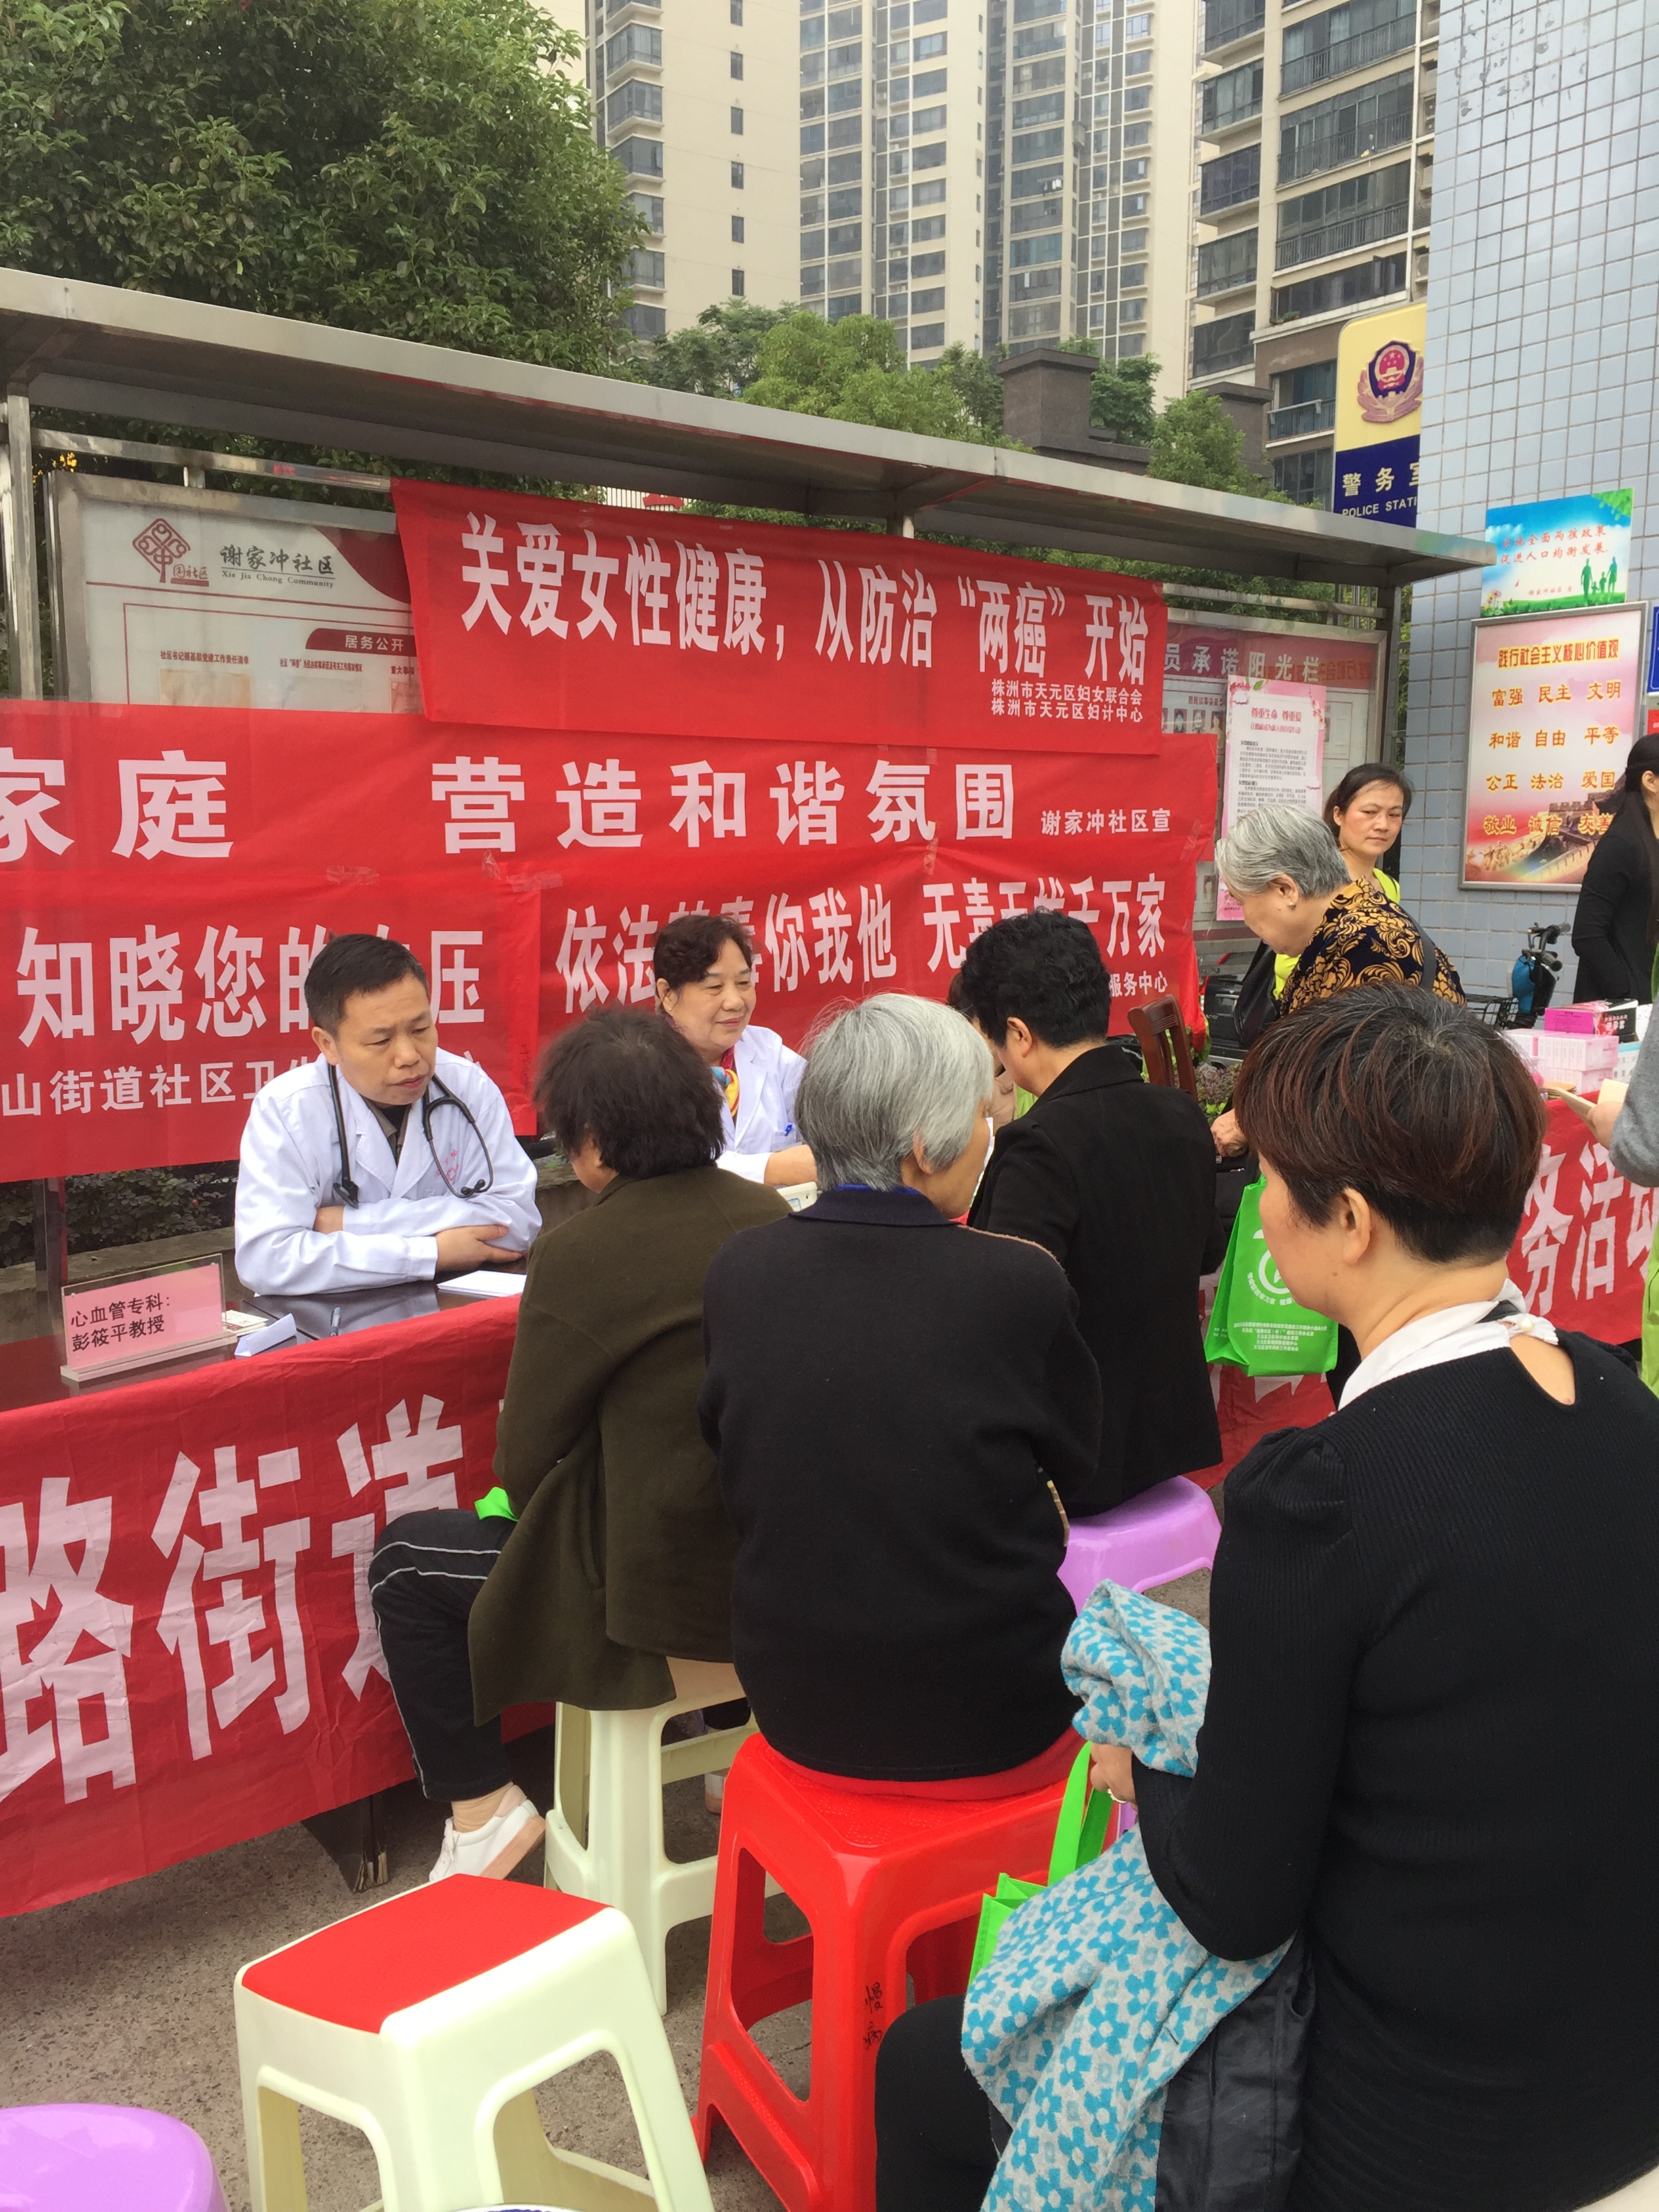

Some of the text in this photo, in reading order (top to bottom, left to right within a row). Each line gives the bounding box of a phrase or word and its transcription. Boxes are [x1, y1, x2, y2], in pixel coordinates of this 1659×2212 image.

[1342, 504, 1379, 516] POLICE
[220, 544, 334, 575] 谢家冲社区
[222, 570, 334, 588] Xie Jia Chong Community
[345, 634, 404, 652] 居务公开
[1498, 639, 1619, 668] 践行社会主义核心价值观
[1164, 643, 1319, 682] 员承诺阳光栏
[991, 678, 1142, 705] 株洲市天元区妇女联合会
[1492, 681, 1621, 707] 富强 民主 文明
[991, 697, 1143, 723] 株洲市天元区妇计中心
[1489, 726, 1620, 749] 和谐 自由 平等
[1486, 771, 1615, 791] 公正 法治 爱国
[0, 748, 1015, 862] 家庭 营造和谐氛围
[1041, 808, 1171, 836] 谢家冲社区宣
[1484, 813, 1614, 835] 敬业 诚信 友善
[556, 883, 897, 1014] 依法你我他
[17, 924, 485, 1048] 知晓您的压
[71, 1315, 165, 1352] 彭筱平教授
